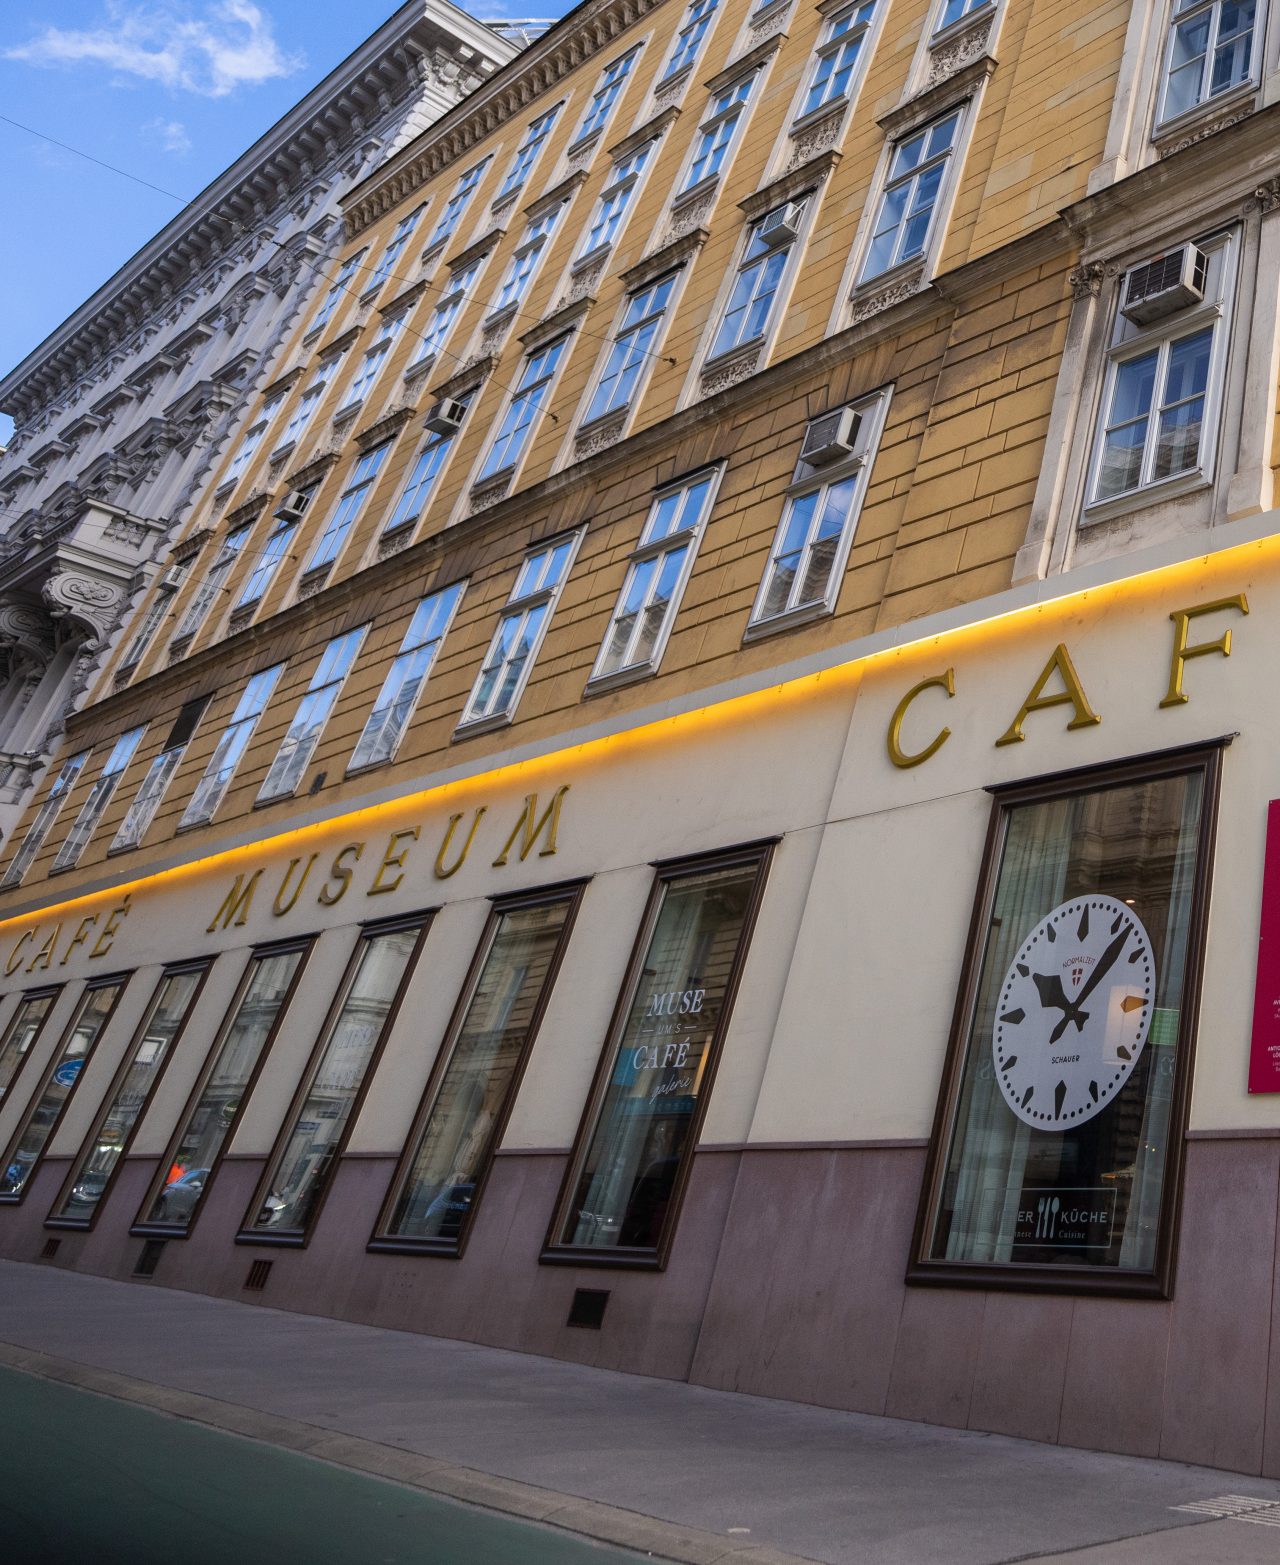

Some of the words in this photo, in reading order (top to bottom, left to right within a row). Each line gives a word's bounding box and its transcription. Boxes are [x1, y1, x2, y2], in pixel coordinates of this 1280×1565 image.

[3, 893, 131, 976] CAFÉ
[205, 784, 571, 933] MUSEUM
[646, 989, 706, 1017] MUSE
[632, 1036, 690, 1070] CAFÉ
[1051, 1055, 1080, 1064] SCHAUER
[648, 1073, 693, 1104] galerie
[1058, 1230, 1086, 1239] Cuisine
